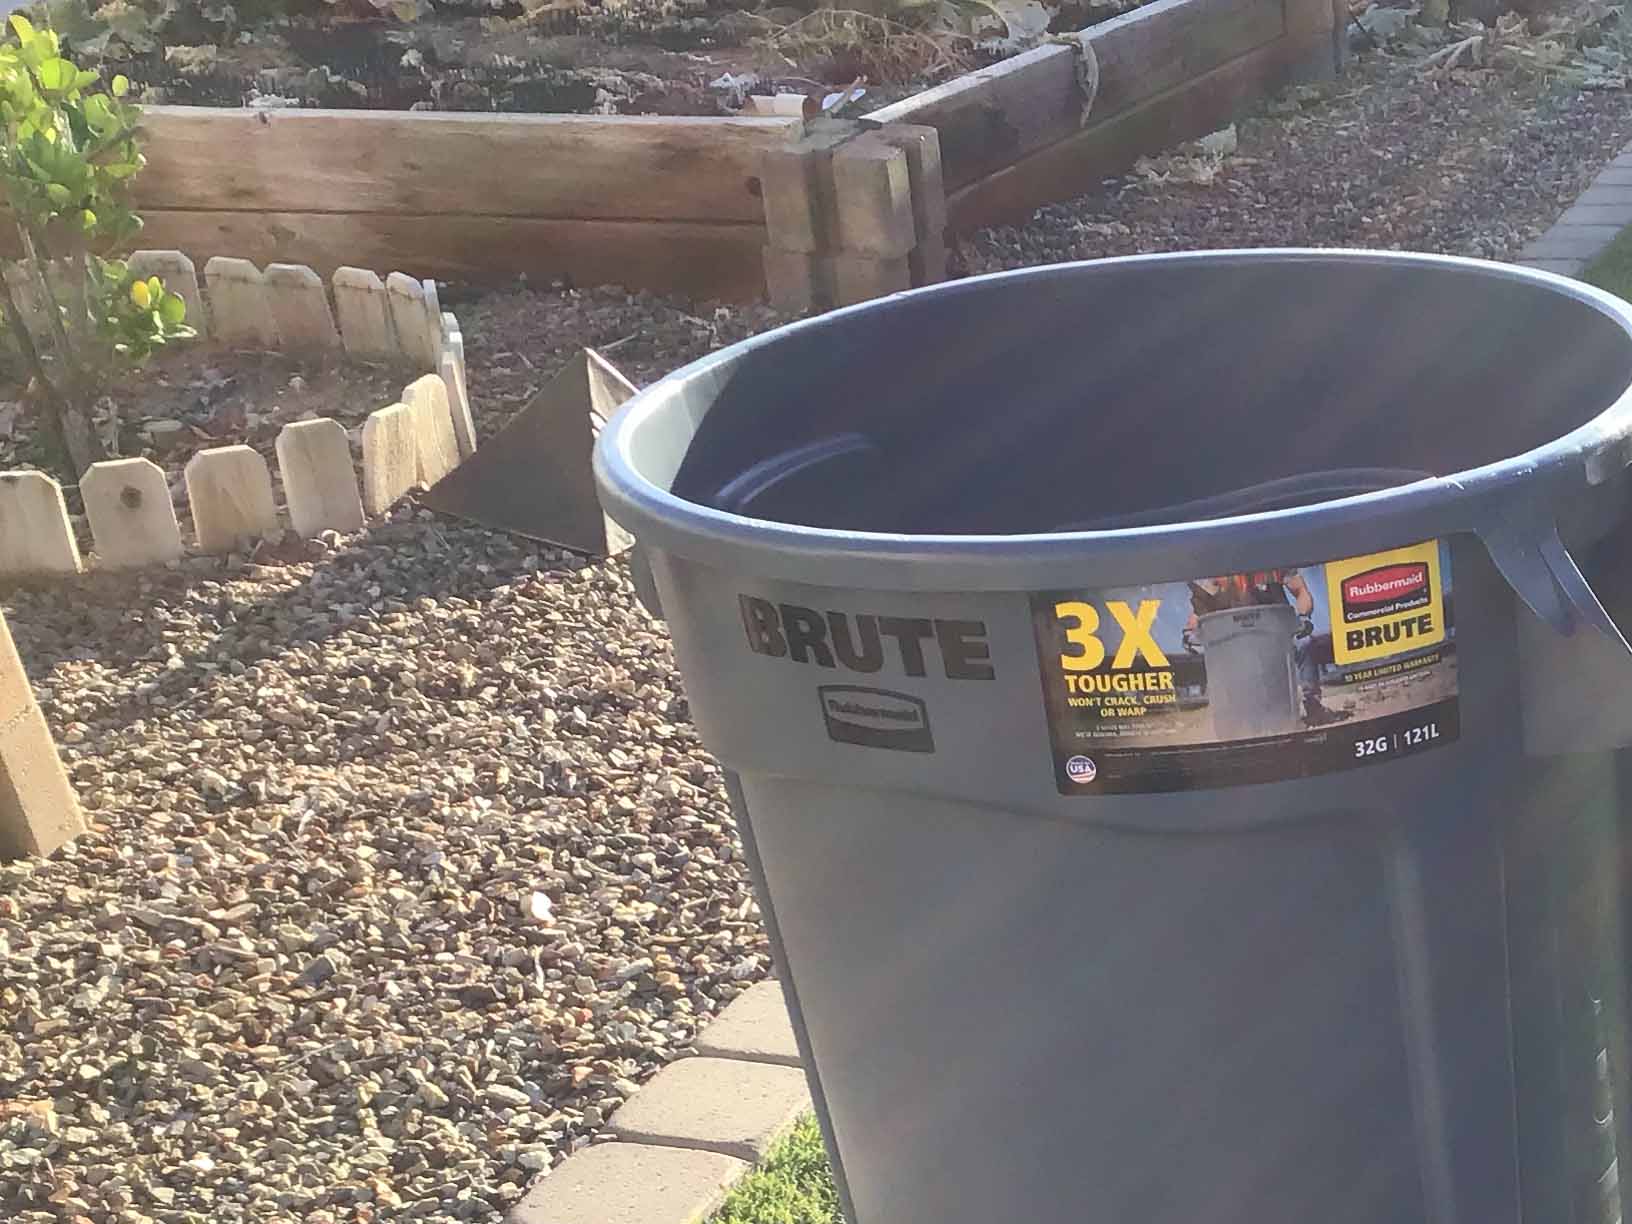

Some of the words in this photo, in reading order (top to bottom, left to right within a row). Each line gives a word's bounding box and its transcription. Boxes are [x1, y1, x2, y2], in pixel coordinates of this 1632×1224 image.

[1349, 572, 1423, 597] Rubbermaid
[1347, 604, 1394, 620] Commercial
[1395, 597, 1428, 610] Products
[738, 594, 996, 681] BRUTE
[1055, 599, 1171, 671] 3X
[1346, 613, 1434, 651] BRUTE
[1064, 671, 1175, 693] TOUGHER
[1067, 696, 1101, 707] WON'T
[1143, 694, 1176, 705] CRUSH
[1100, 708, 1115, 717] OR
[1117, 707, 1147, 717] WARP
[1354, 736, 1388, 758] 32G
[1403, 723, 1440, 746] 121L
[1070, 765, 1091, 774] USA
